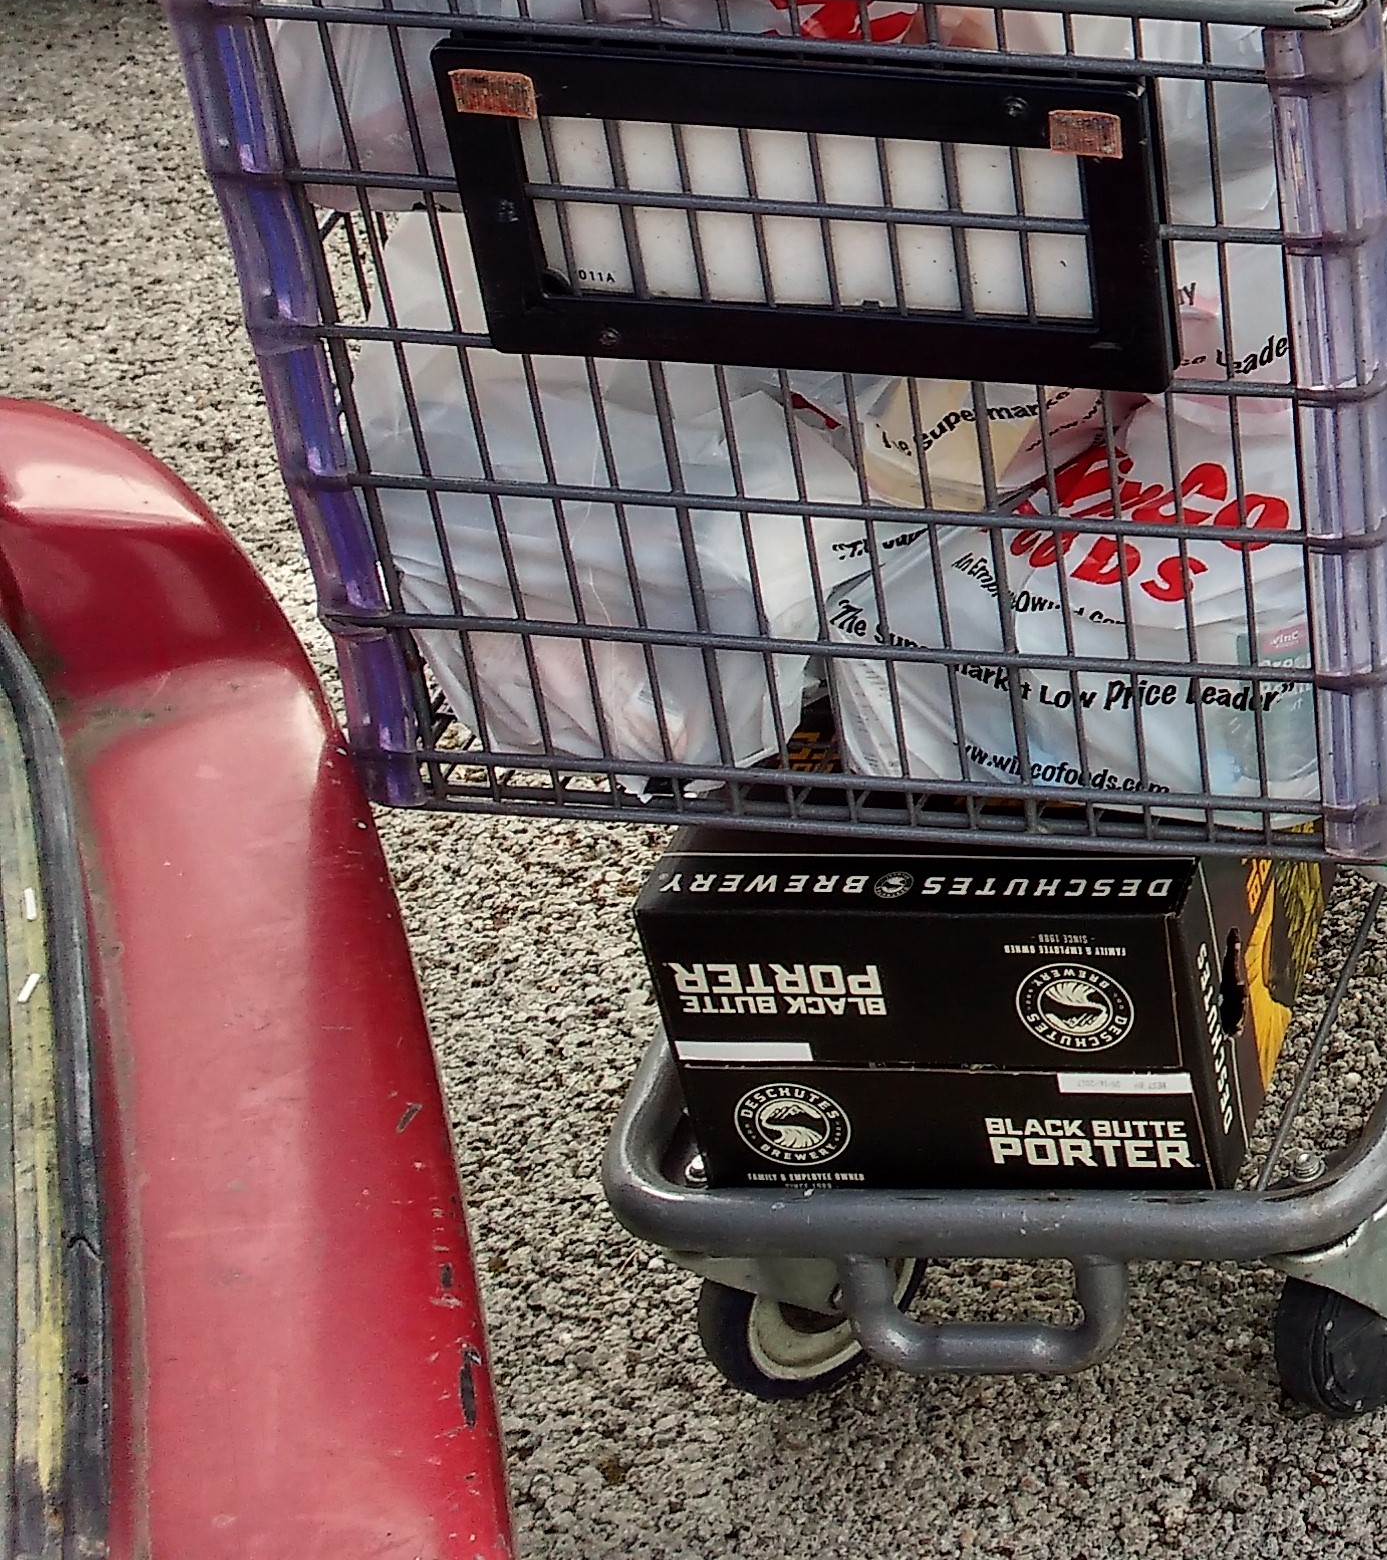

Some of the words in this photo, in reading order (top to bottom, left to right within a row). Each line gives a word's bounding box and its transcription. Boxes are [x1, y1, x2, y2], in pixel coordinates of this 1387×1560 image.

[1216, 335, 1289, 375] Leade
[1010, 525, 1208, 602] OODS
[1040, 683, 1097, 710] Low
[1104, 679, 1177, 711] Price
[659, 873, 870, 893] BREWERY
[921, 877, 1173, 897] DESCHUTES
[1004, 944, 1036, 954] OWNED
[1038, 945, 1083, 955] EMPLOYEE
[1094, 946, 1127, 957] FAMILY
[668, 962, 883, 995] PORTER
[1033, 968, 1110, 990] BREWERY
[679, 995, 778, 1014] BUTTE
[783, 996, 888, 1016] BLACK
[1026, 1012, 1129, 1048] DESCHUTES
[1198, 942, 1233, 1136] DESCHUTES
[741, 1087, 840, 1120] DESCHUTES
[984, 1117, 1086, 1137] BLACK
[1091, 1120, 1187, 1138] BUTTE
[760, 1143, 837, 1161] BREWERY
[989, 1137, 1196, 1167] PORTER
[747, 1172, 777, 1182] FAMILY
[788, 1172, 832, 1181] EMPLOYEE
[834, 1172, 865, 1181] OWNED
